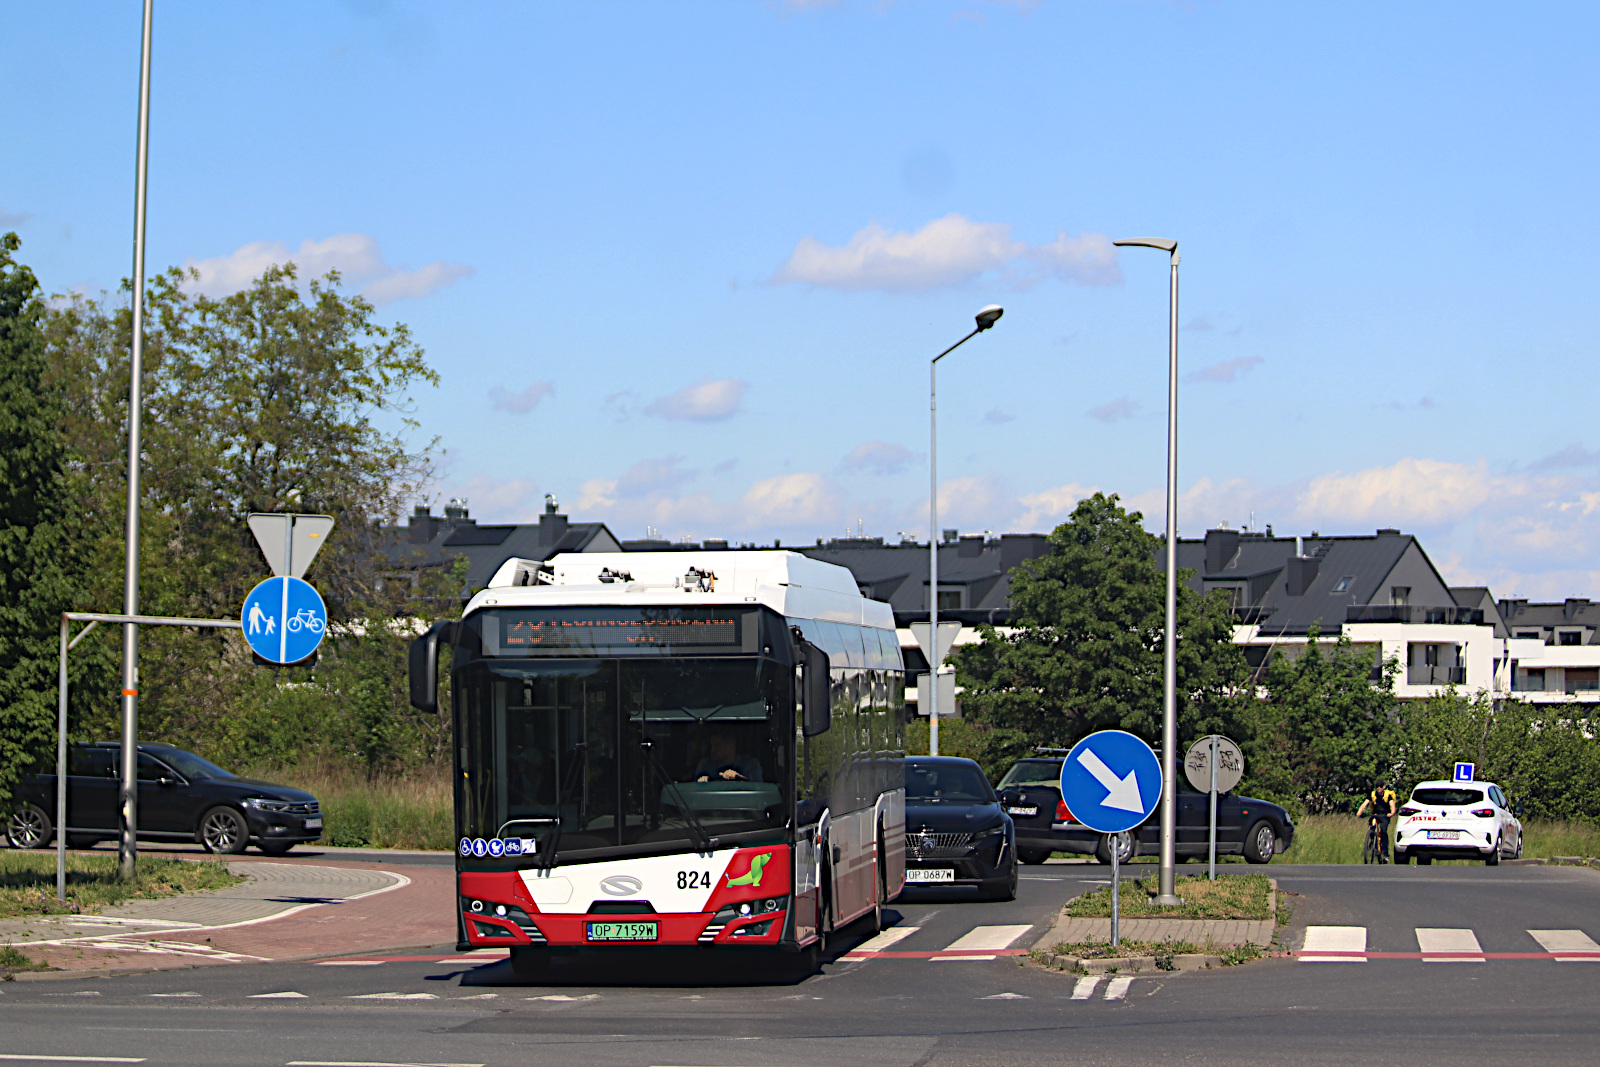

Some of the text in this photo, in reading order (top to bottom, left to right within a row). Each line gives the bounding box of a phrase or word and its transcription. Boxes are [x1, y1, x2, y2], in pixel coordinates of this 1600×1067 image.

[1460, 766, 1469, 779] L
[677, 871, 711, 889] 824
[909, 870, 952, 879] OP 0687W
[595, 924, 654, 936] OP 7159W
